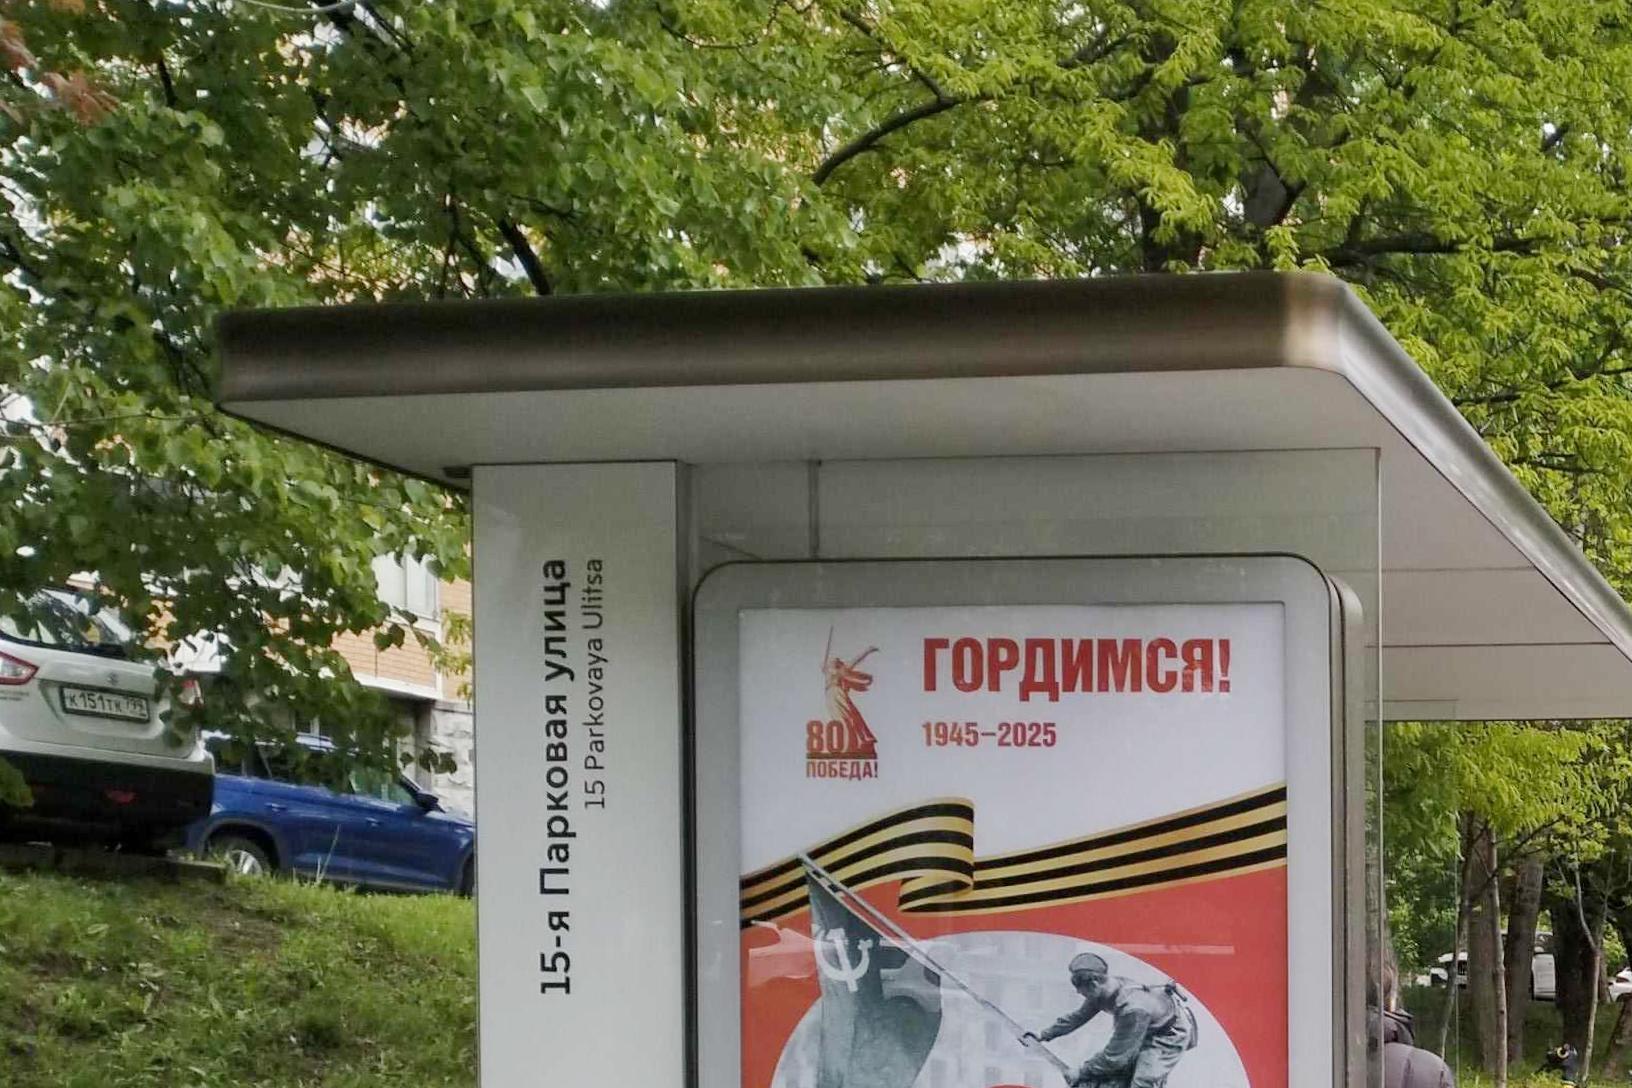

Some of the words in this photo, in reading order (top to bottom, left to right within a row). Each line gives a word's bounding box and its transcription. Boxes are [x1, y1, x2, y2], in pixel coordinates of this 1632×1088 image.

[542, 559, 575, 682] улица
[580, 559, 604, 630] Ulitsa
[581, 638, 609, 770] Parkovaya
[922, 636, 1232, 702] ГОРДИМСЯ!
[806, 719, 846, 754] 80
[806, 760, 878, 781] ПОБЕДА!
[539, 694, 577, 895] Парковая
[584, 780, 606, 810] 15
[539, 911, 571, 995] 15-я
